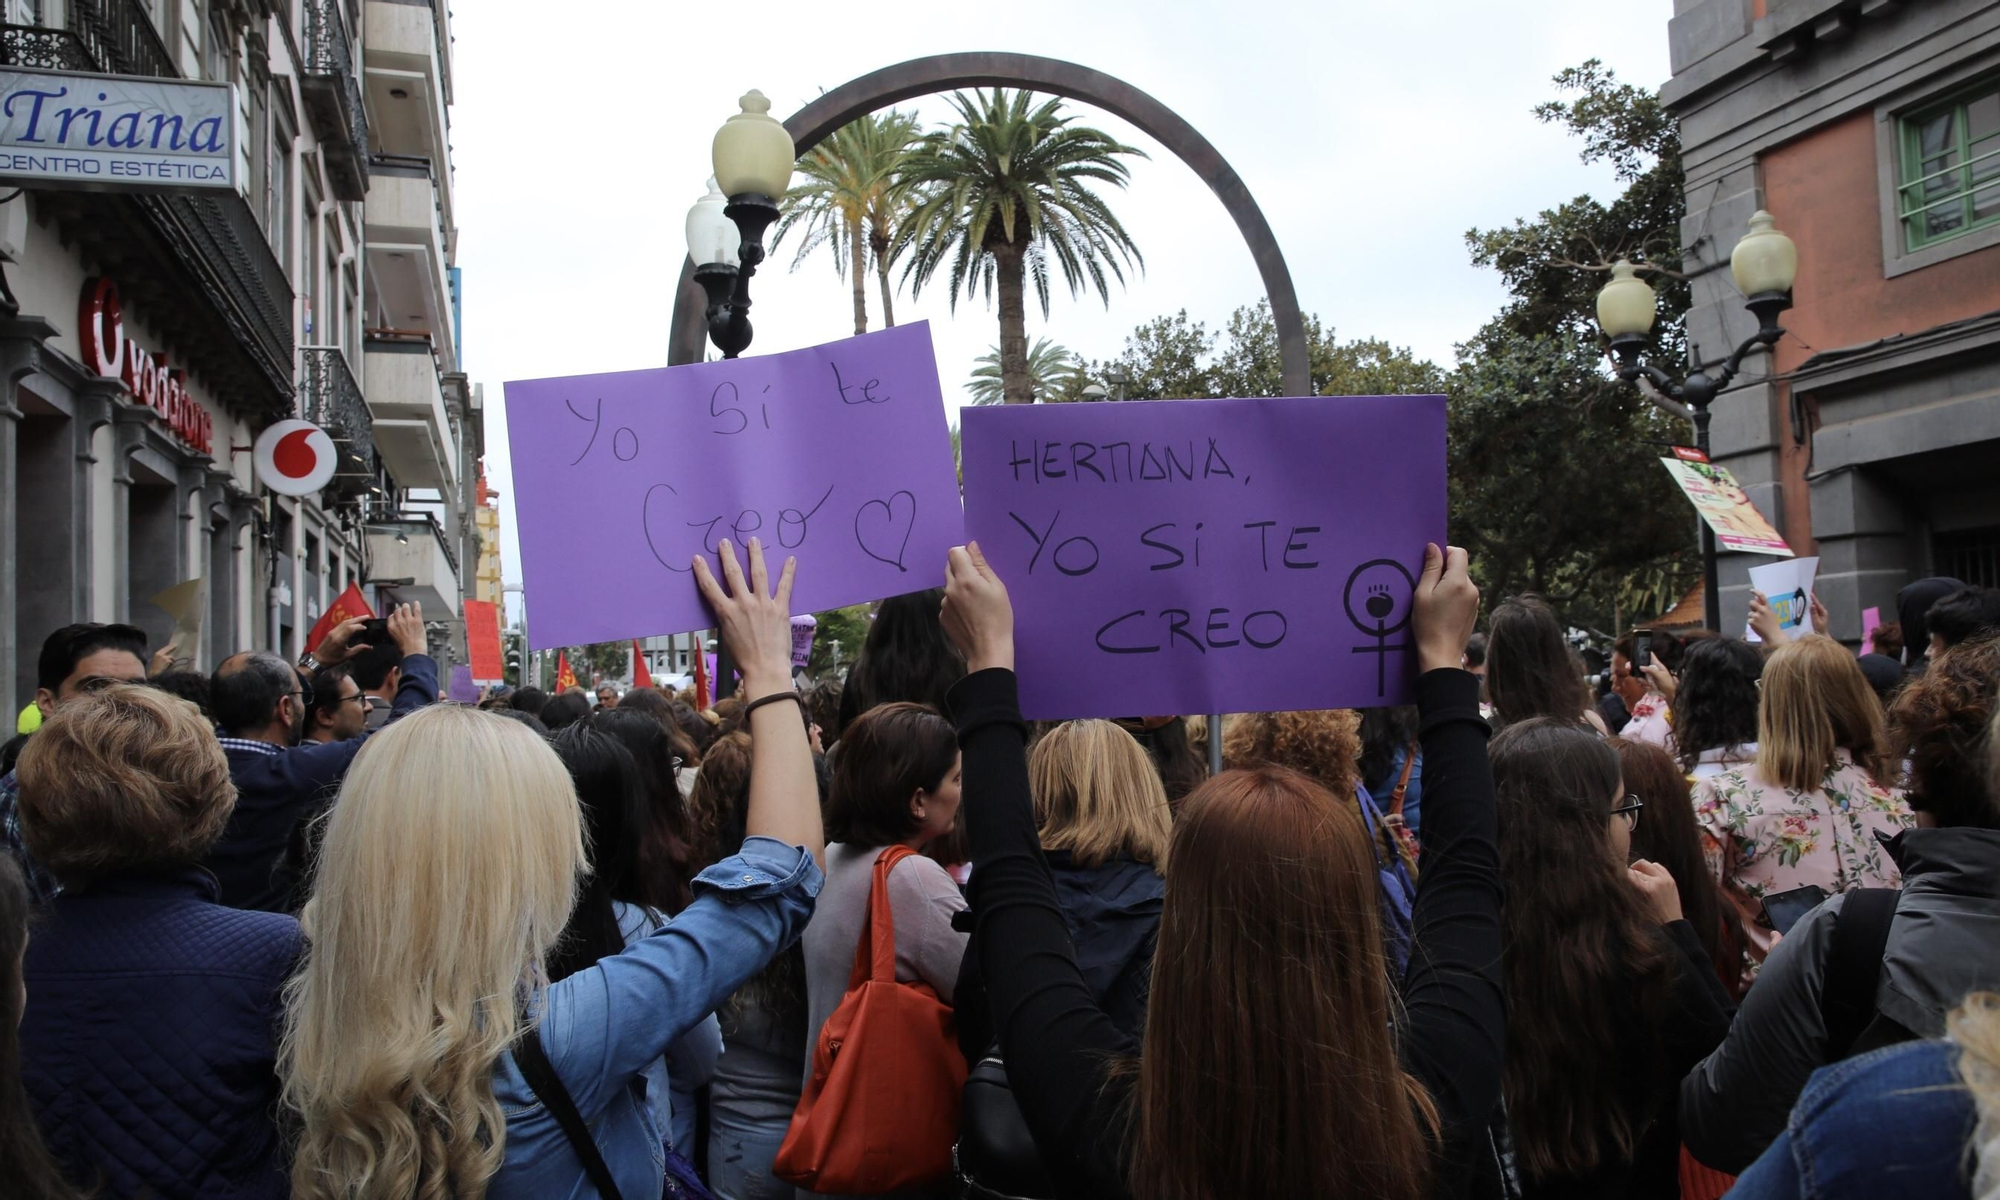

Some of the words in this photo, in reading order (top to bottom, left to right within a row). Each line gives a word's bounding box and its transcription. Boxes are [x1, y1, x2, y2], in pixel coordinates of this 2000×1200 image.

[4, 86, 225, 153] Triana
[0, 154, 101, 175] CENTRO
[110, 160, 226, 180] ESTÉTICA
[565, 398, 640, 466] Yo
[830, 361, 892, 405] te
[643, 483, 834, 573] Creo
[1244, 520, 1322, 572] TE
[1095, 607, 1288, 655] CREO
